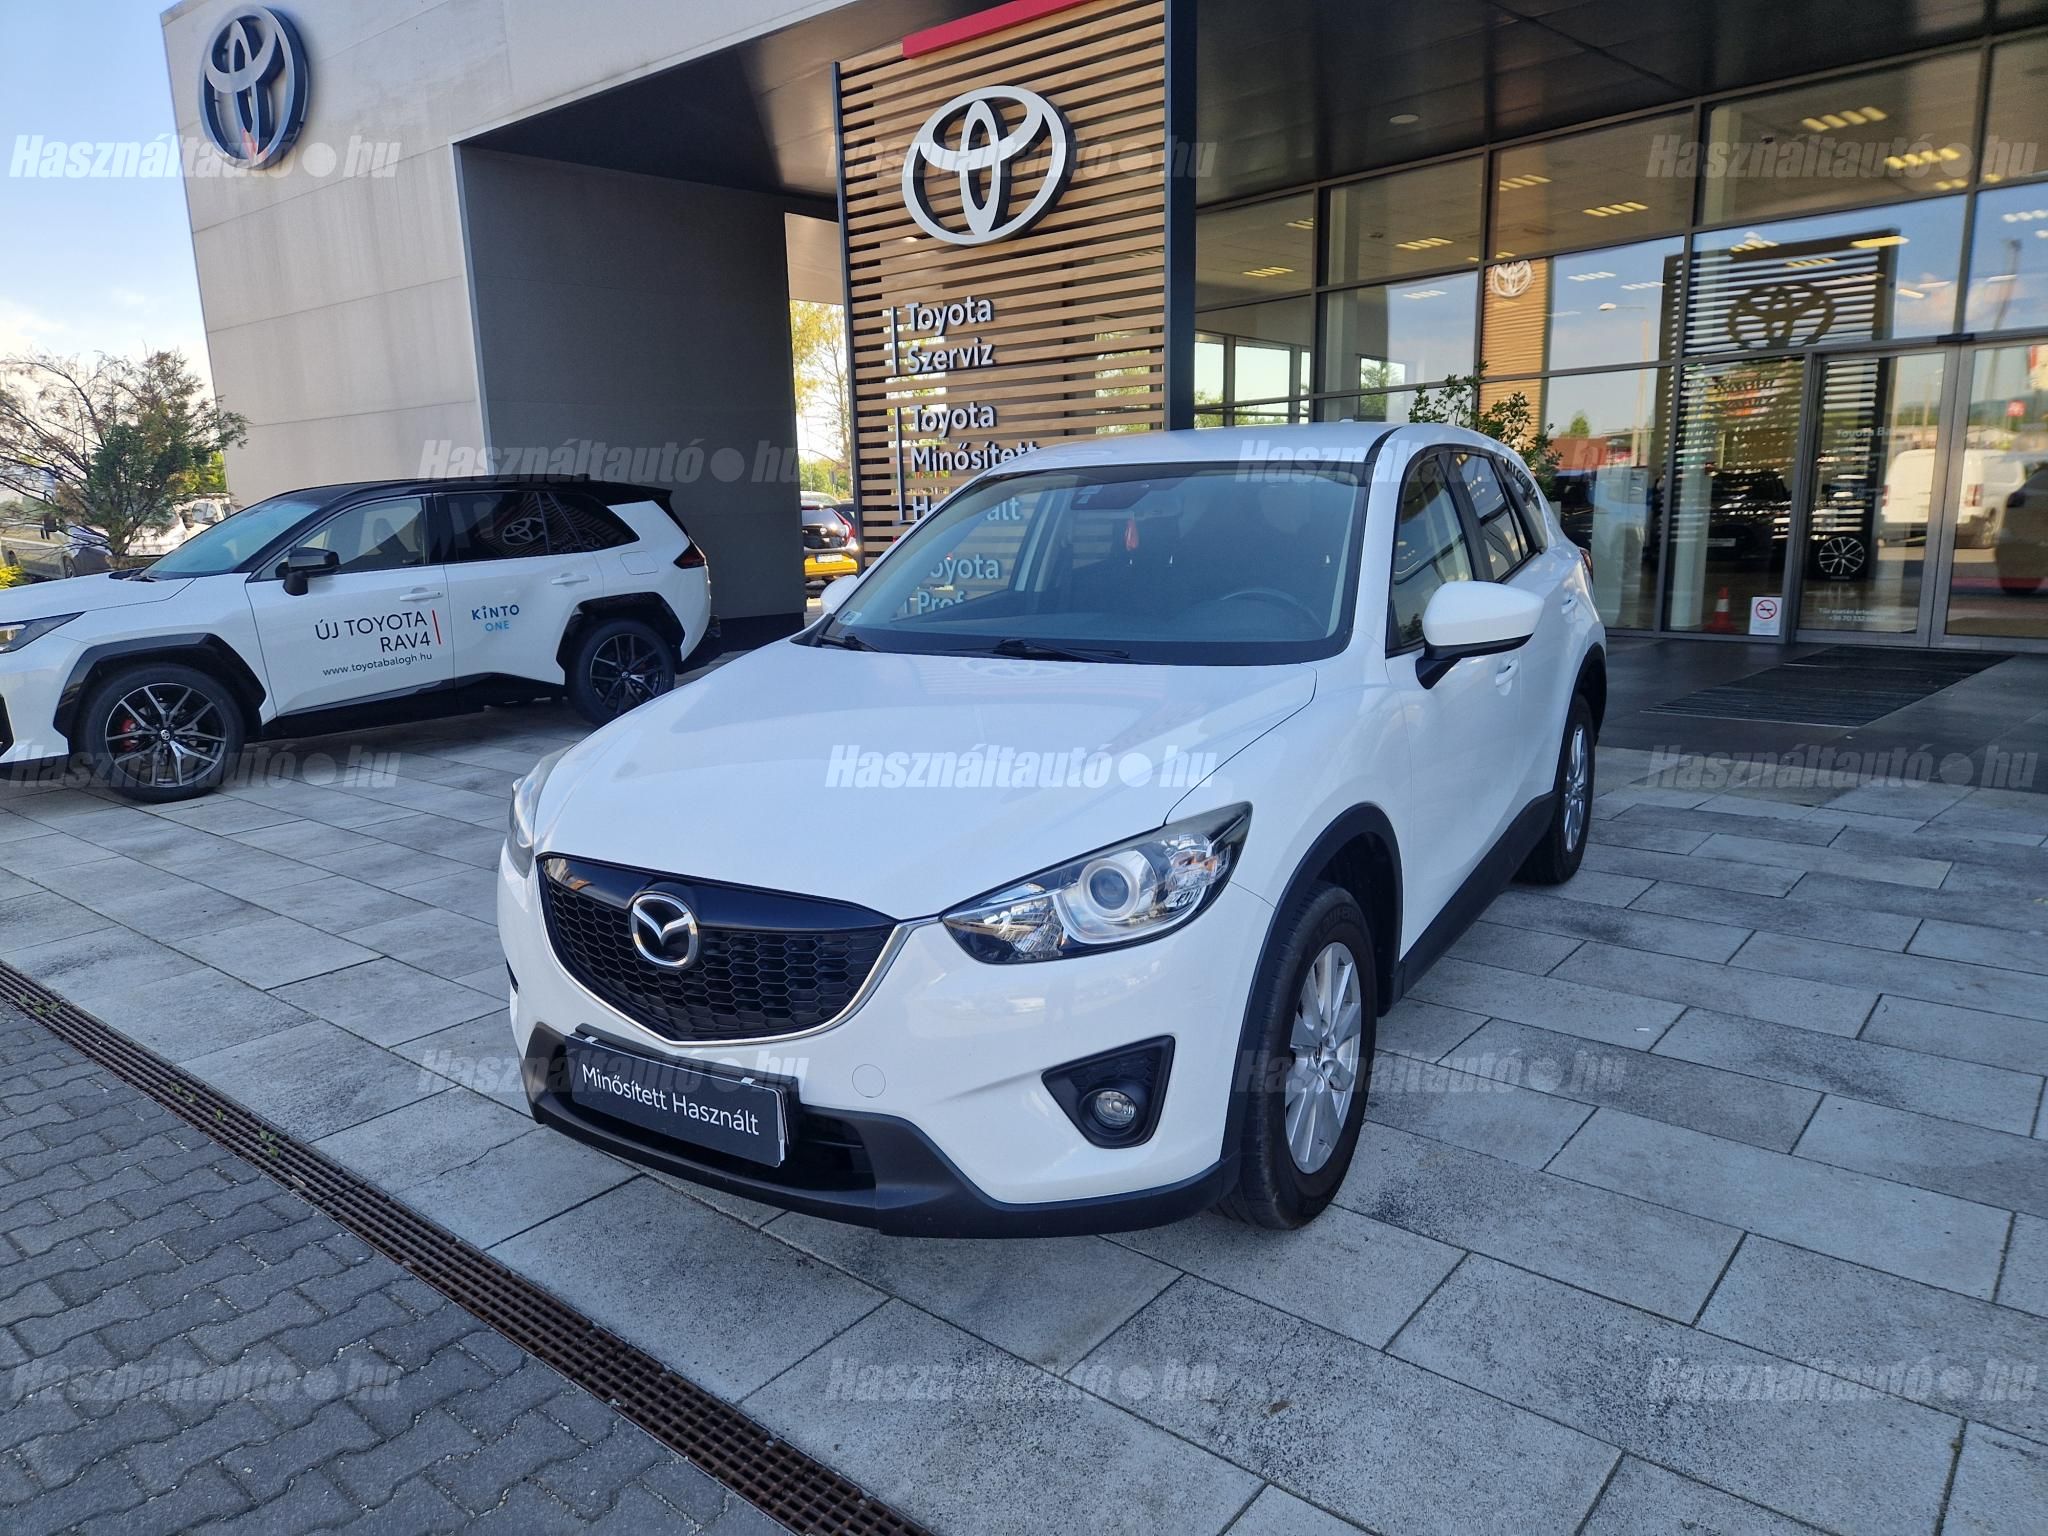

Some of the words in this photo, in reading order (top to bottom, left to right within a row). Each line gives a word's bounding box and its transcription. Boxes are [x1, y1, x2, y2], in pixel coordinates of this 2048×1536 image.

[905, 296, 994, 336] Toyota
[907, 337, 995, 374] Szerviz
[909, 401, 997, 438] Toyota
[929, 553, 1000, 586] oyota
[315, 619, 339, 640] ÚJ
[344, 611, 428, 637] TOYOTA
[380, 631, 431, 653] RAV4
[485, 620, 510, 632] ONE
[322, 652, 433, 677] www.toyotabalogh.hu
[582, 1063, 668, 1111] Minősített
[673, 1092, 760, 1136] Használt
